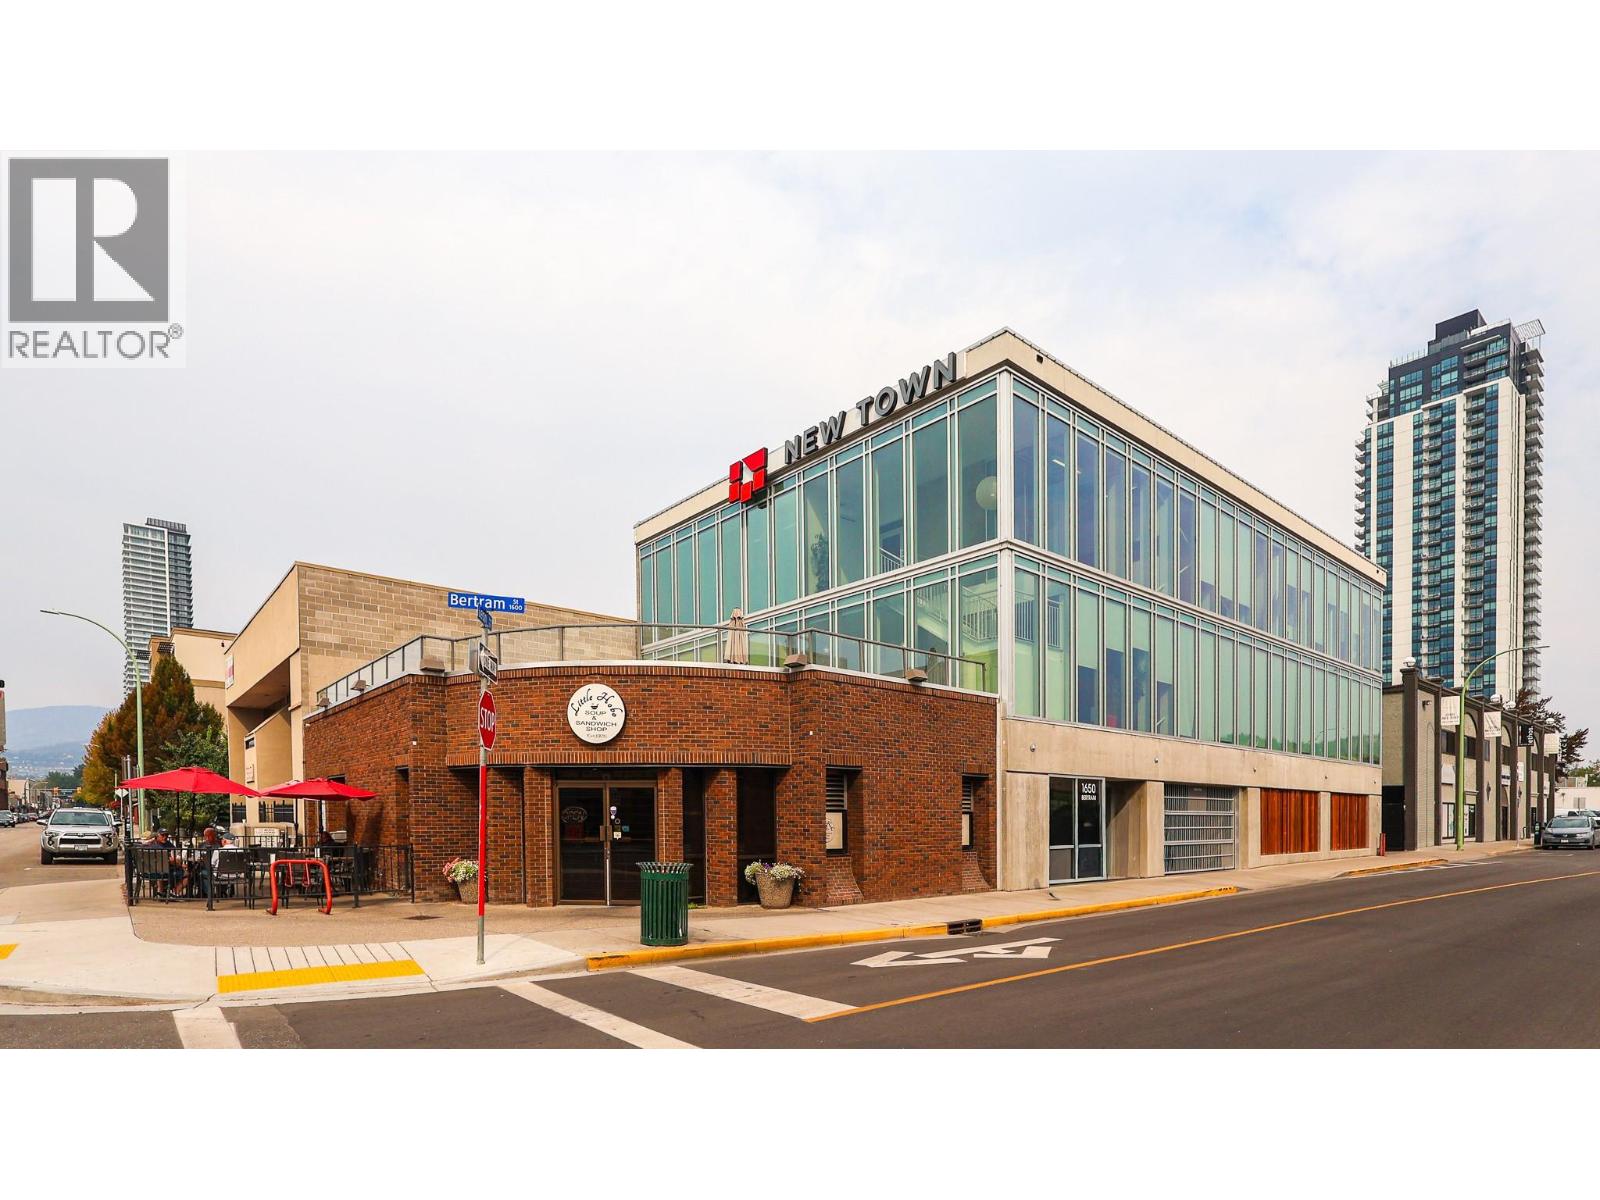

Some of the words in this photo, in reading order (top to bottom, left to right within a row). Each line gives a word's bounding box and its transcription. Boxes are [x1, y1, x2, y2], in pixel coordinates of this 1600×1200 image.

[784, 410, 847, 465] NEW
[856, 351, 957, 426] TOWN
[450, 593, 505, 609] Bertram
[571, 688, 593, 717] Little
[480, 707, 495, 732] STOP
[1081, 783, 1096, 793] 1650
